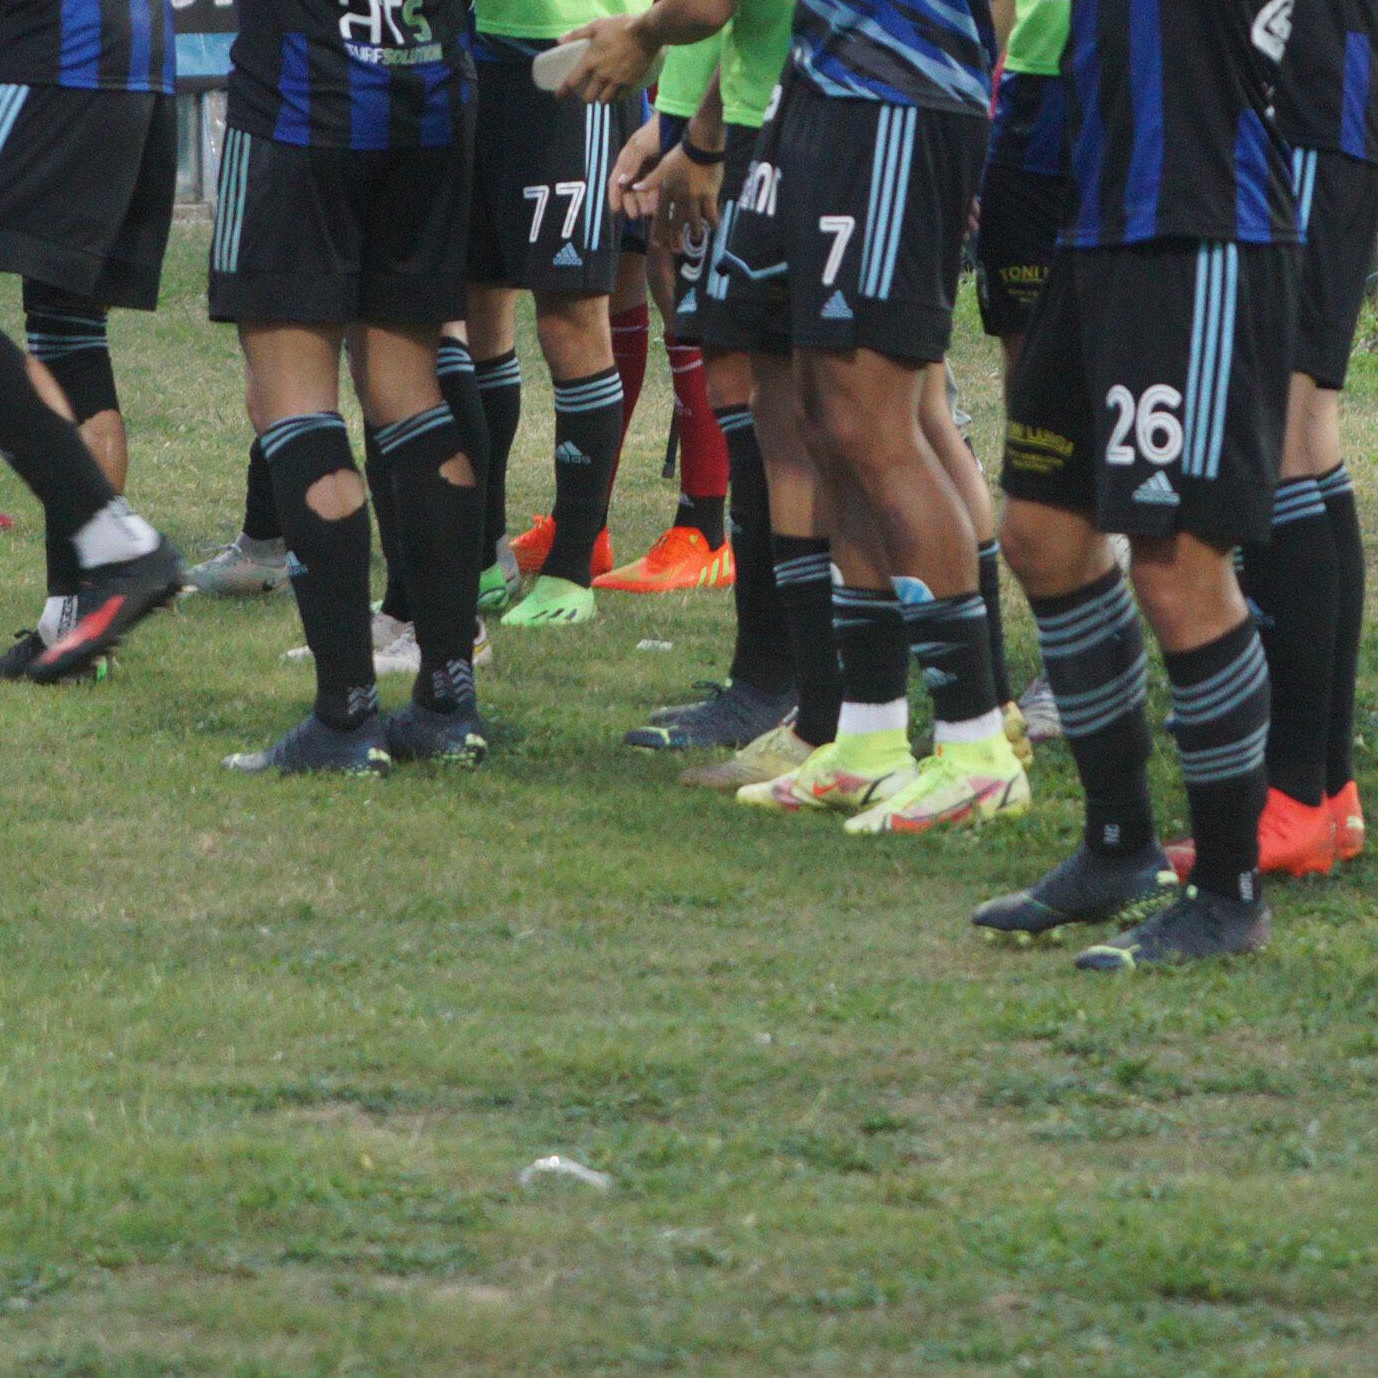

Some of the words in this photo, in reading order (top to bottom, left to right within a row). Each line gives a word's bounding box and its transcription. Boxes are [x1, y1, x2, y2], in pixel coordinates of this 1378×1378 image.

[522, 181, 588, 243] 77
[818, 214, 856, 286] 7
[1104, 383, 1183, 465] 26
